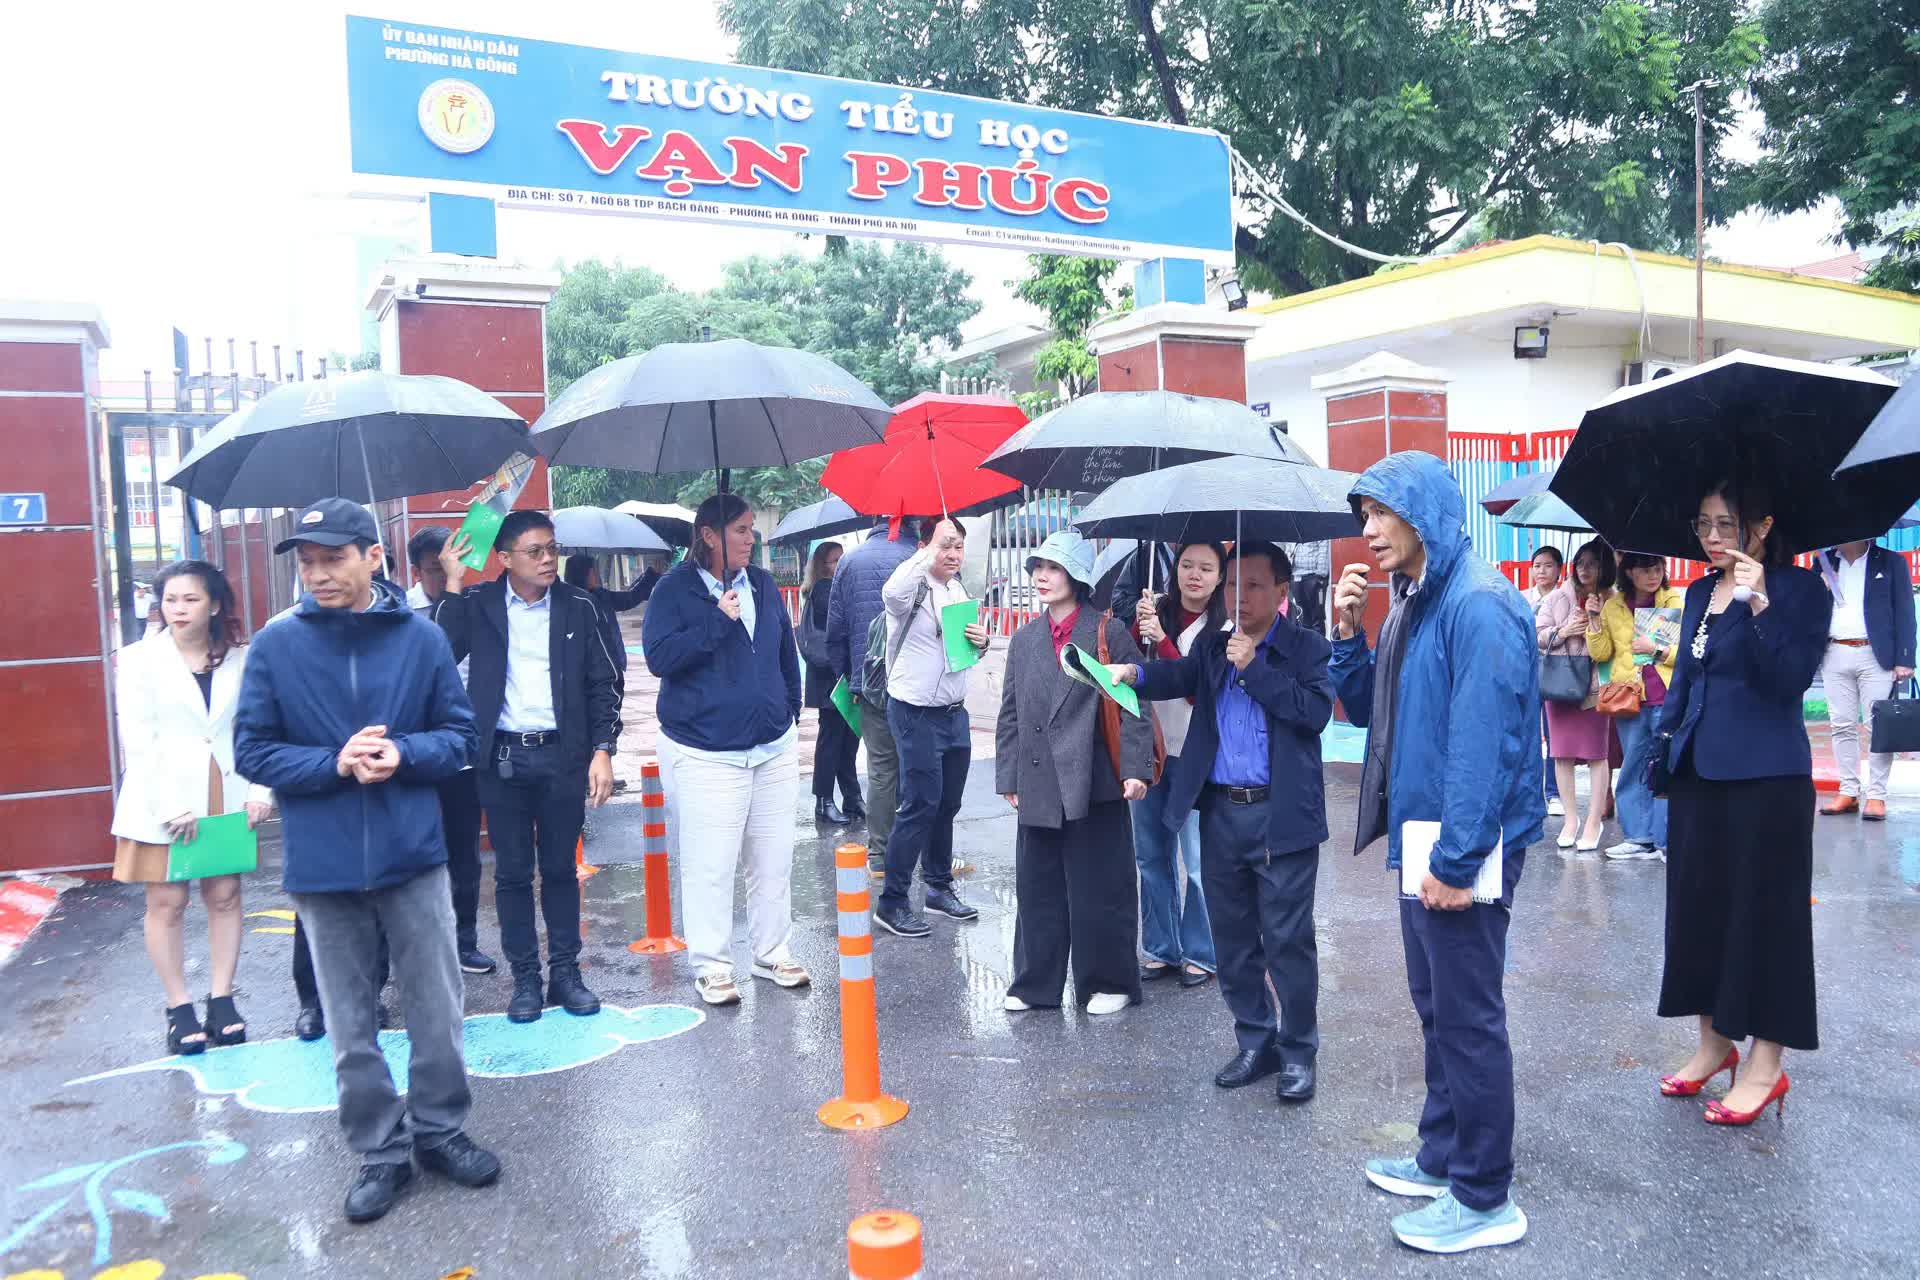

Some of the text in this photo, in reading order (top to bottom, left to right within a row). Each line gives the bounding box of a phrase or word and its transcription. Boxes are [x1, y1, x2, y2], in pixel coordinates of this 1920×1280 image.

[601, 71, 1069, 158] TRƯỜNG TIỂU HỌC
[557, 119, 1110, 223] VẠN PHÚC
[13, 498, 30, 520] 7
